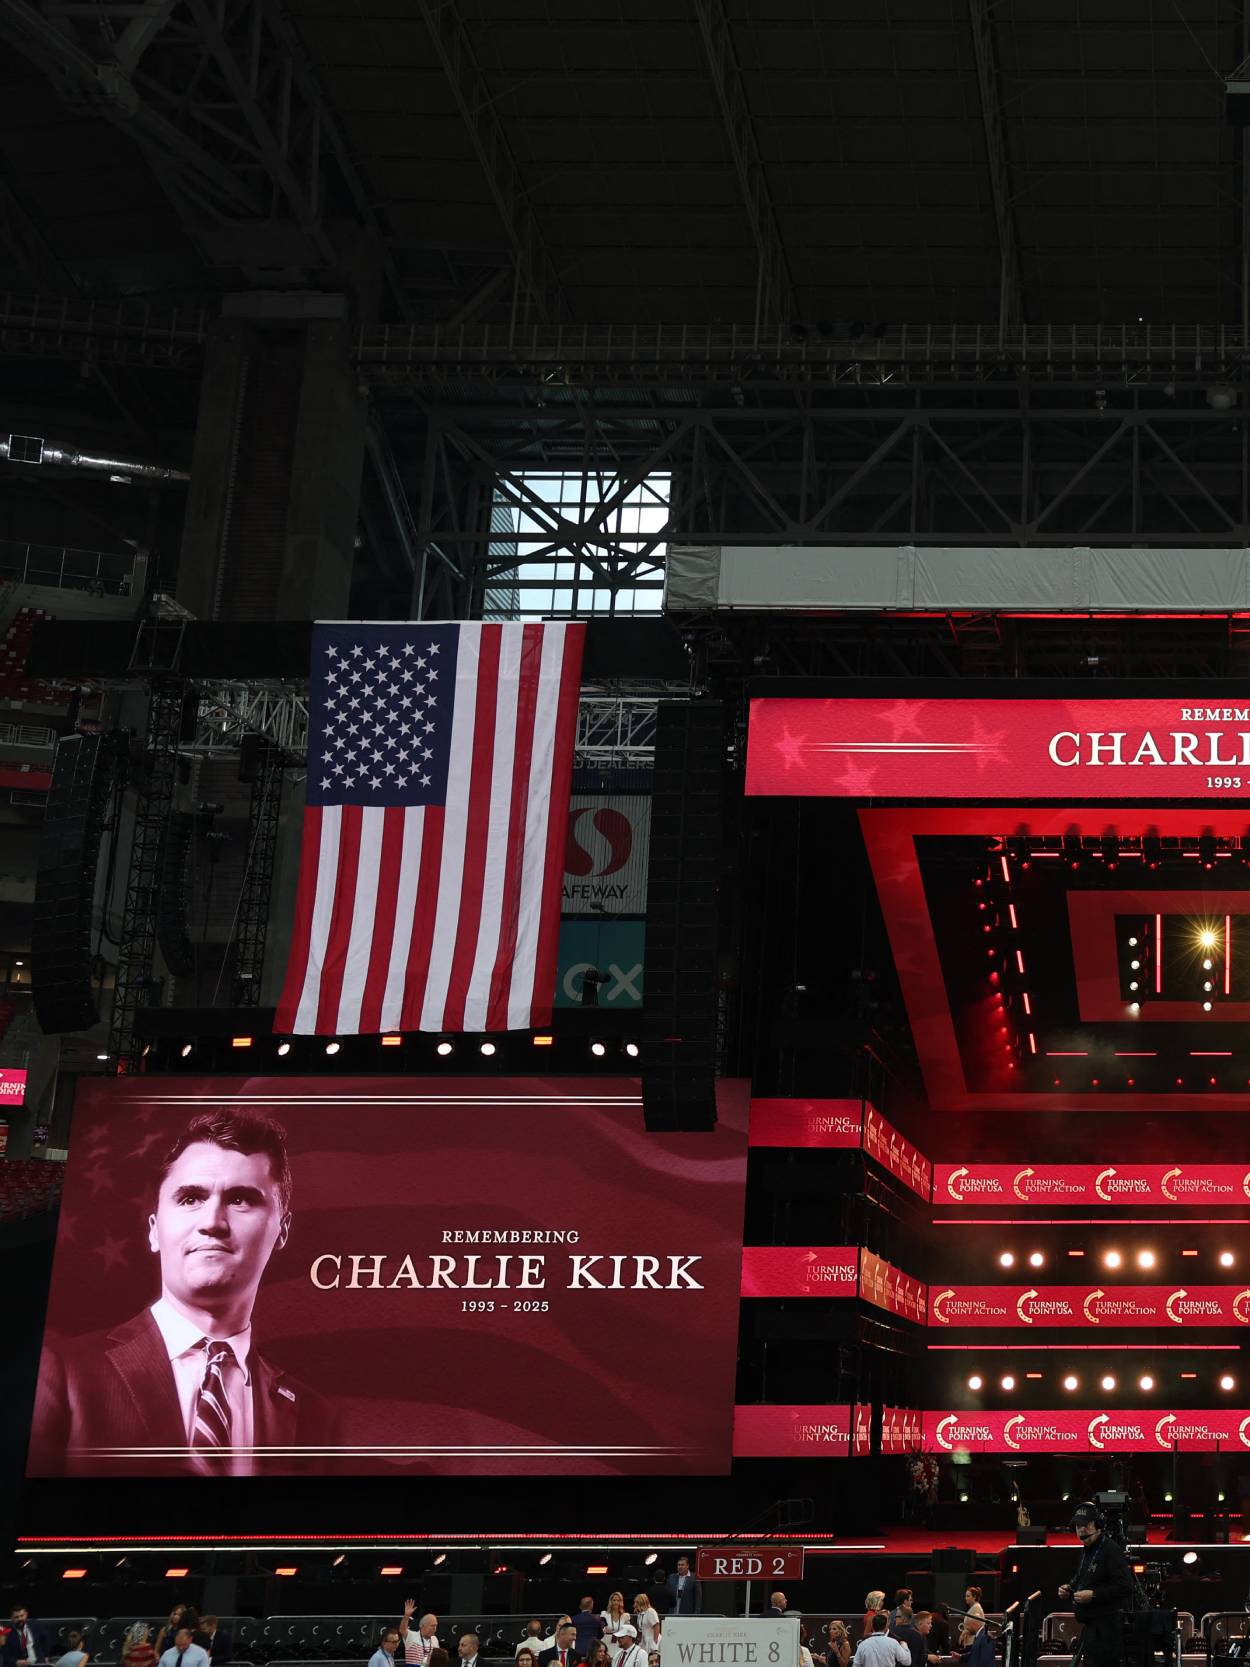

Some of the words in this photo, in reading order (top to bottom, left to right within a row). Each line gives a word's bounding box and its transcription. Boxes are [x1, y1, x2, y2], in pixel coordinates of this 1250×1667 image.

[1207, 776, 1242, 789] 1993
[561, 884, 629, 899] AFEWAY
[554, 963, 643, 1002] OX
[808, 1117, 850, 1125] URNING
[441, 1230, 580, 1244] REMEMBERING
[310, 1254, 546, 1290] CHARLIE
[567, 1255, 705, 1289] KIRK
[807, 1265, 855, 1273] TURNING
[806, 1273, 838, 1281] POINT
[461, 1300, 495, 1312] 1993
[514, 1300, 549, 1312] 2025
[1178, 1300, 1218, 1308] TURNING
[794, 1425, 838, 1433] URNING
[713, 1558, 763, 1575] RED
[772, 1557, 785, 1575] 2
[677, 1642, 758, 1663] WHITE
[767, 1641, 780, 1663] 8
